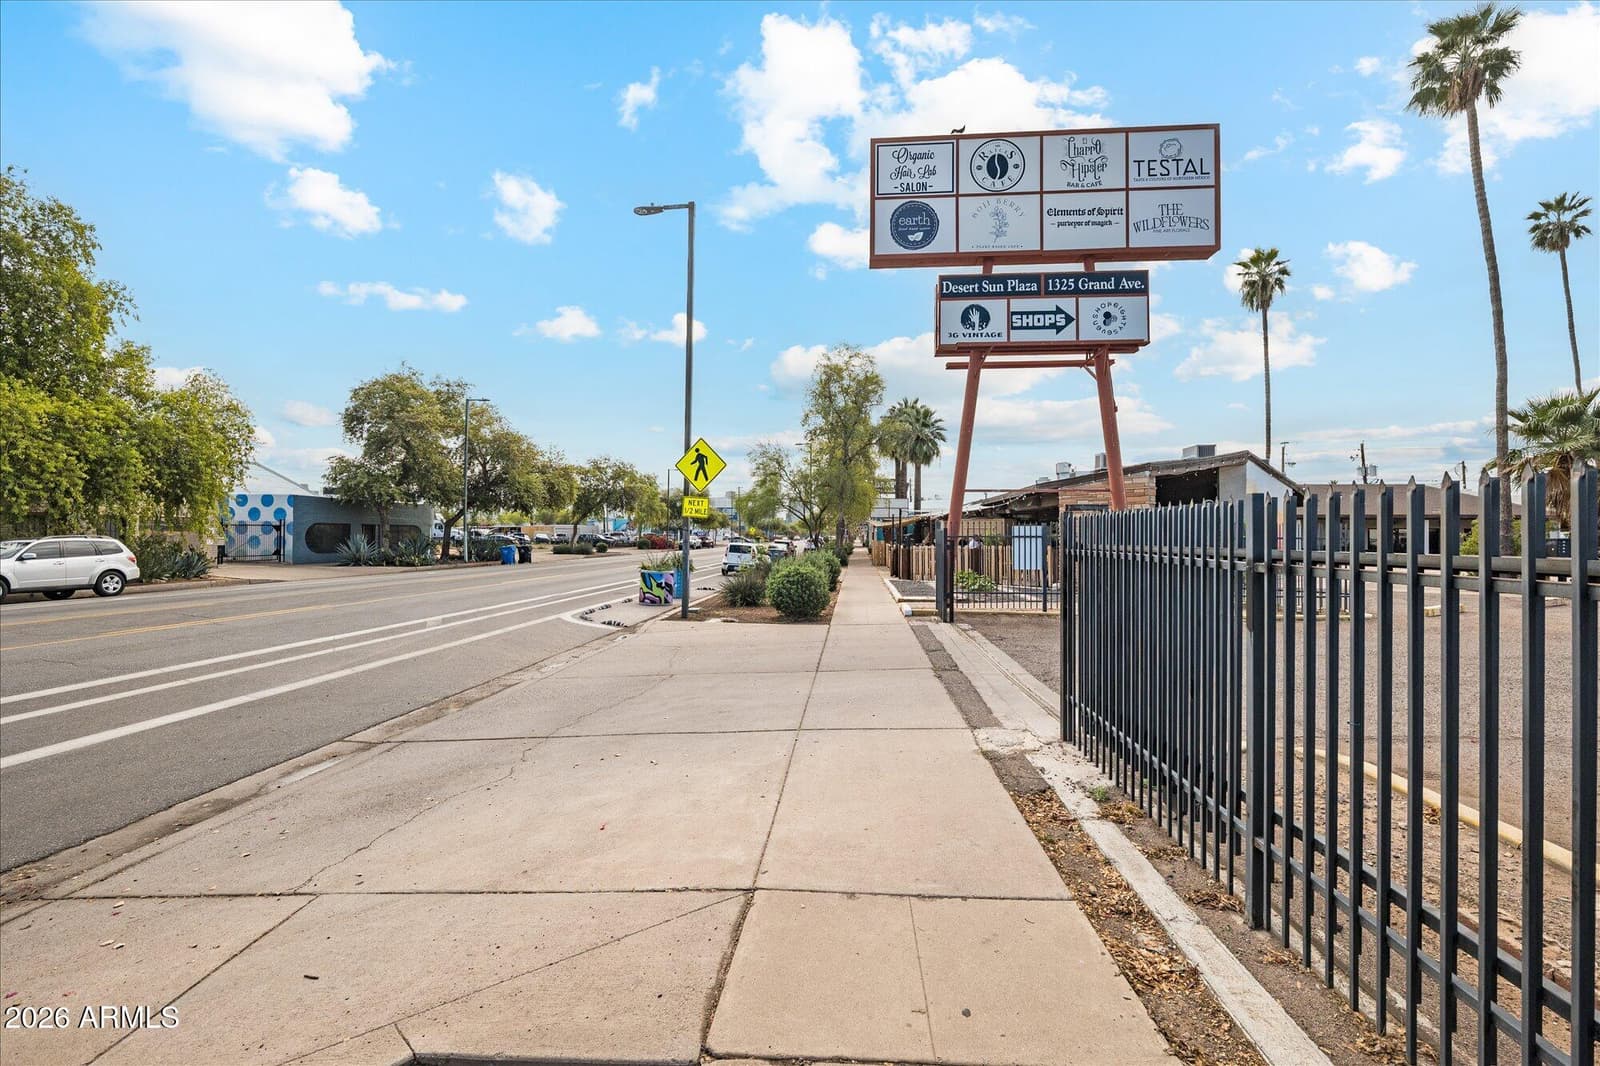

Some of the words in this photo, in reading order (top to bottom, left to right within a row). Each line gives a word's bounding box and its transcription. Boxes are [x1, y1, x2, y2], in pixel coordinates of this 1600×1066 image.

[892, 147, 935, 164] Organic
[890, 165, 916, 180] Hair
[917, 164, 937, 179] Lab
[1133, 158, 1210, 177] TESTAL
[1046, 207, 1087, 217] Elements
[1087, 207, 1097, 216] of
[1096, 206, 1124, 218] Spirit
[1158, 203, 1184, 216] THE
[898, 211, 931, 226] earth
[1132, 215, 1210, 233] WILDFLOWERS
[942, 280, 980, 294] Desert
[981, 279, 1004, 293] Sun
[1006, 278, 1038, 292] Plaza
[1047, 278, 1075, 291] 1325
[1078, 276, 1115, 290] Grand
[1119, 276, 1145, 289] Ave.
[1012, 313, 1066, 327] SHOPS
